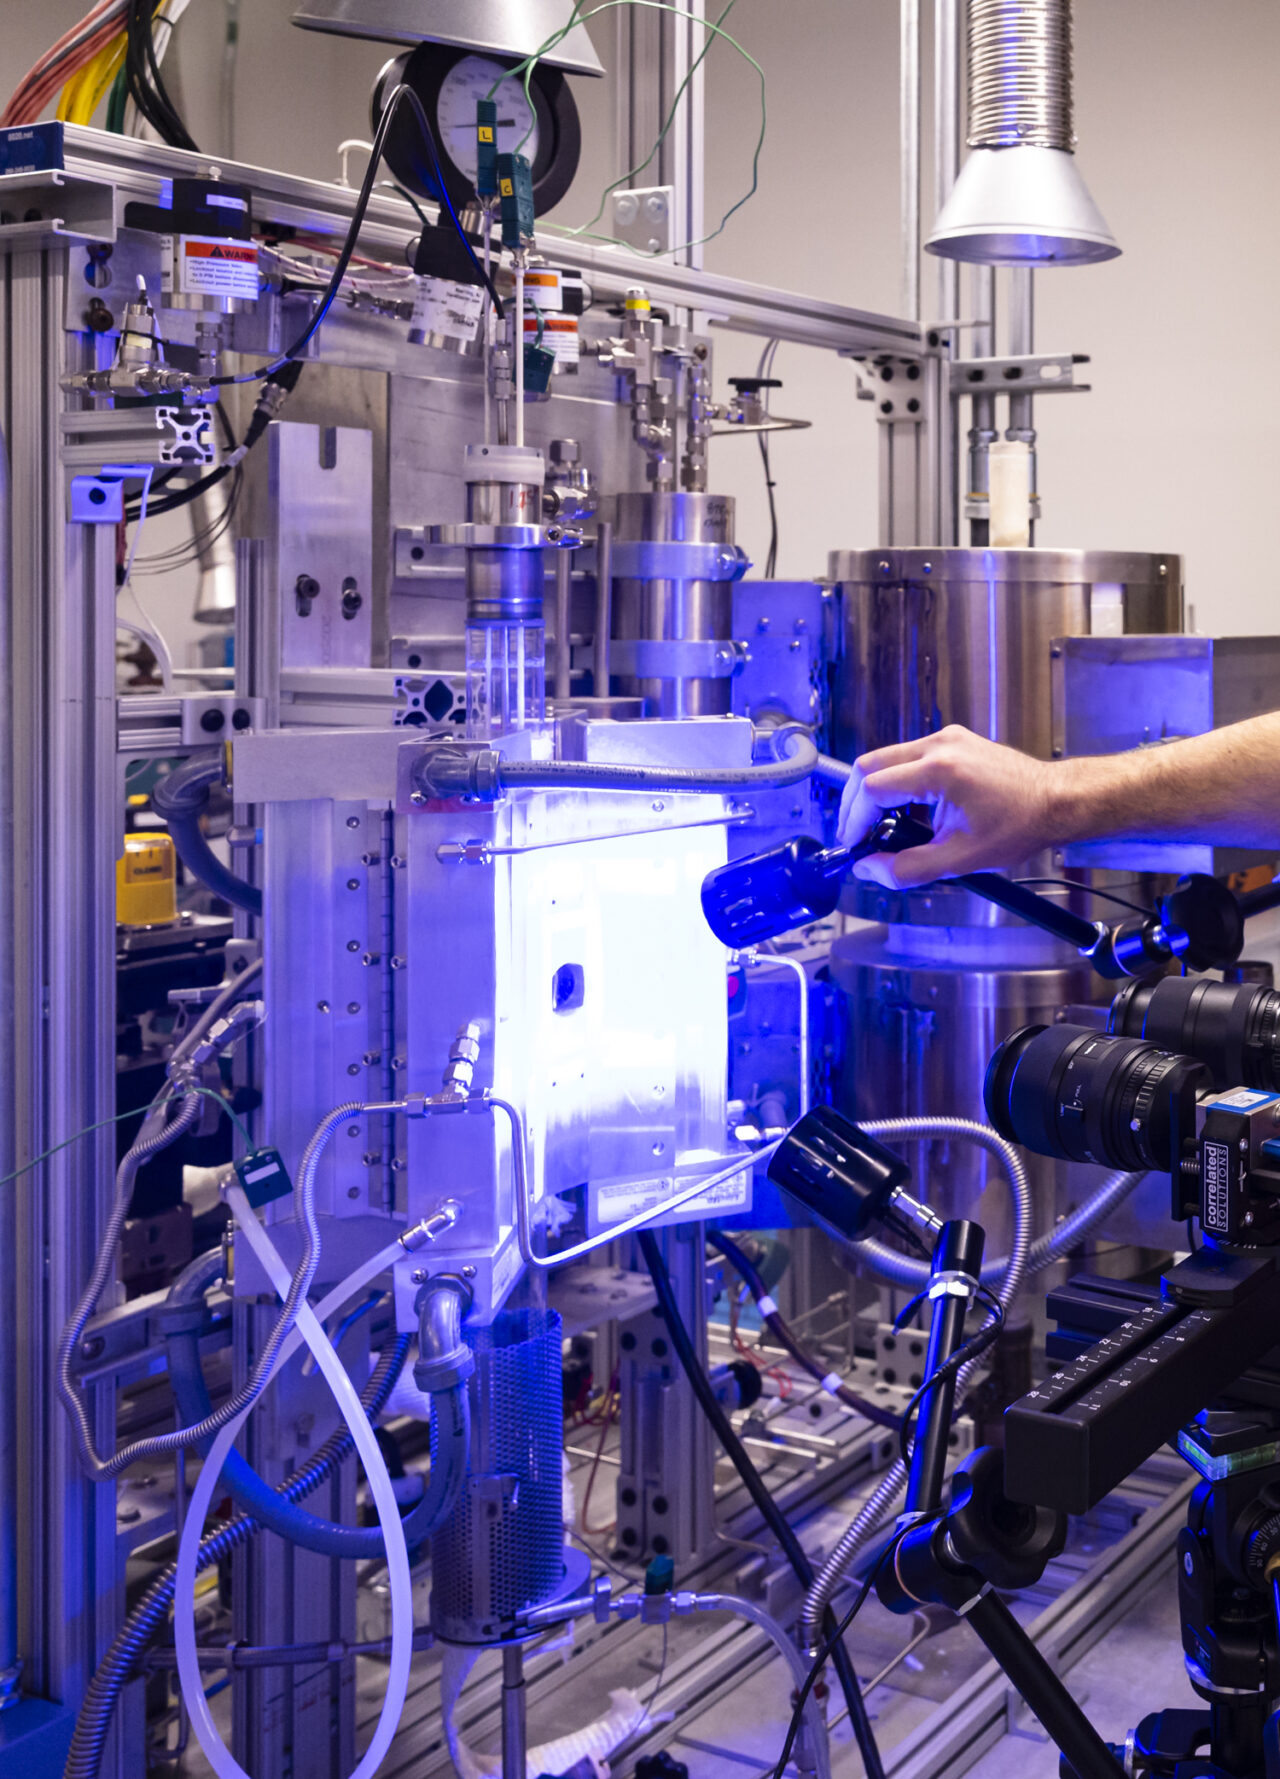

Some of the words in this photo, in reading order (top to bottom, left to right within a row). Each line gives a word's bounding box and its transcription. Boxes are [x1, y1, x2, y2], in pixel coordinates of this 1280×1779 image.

[482, 130, 491, 140] L
[1206, 1146, 1217, 1225] correlated
[1218, 1148, 1227, 1228] SOLUTIONS
